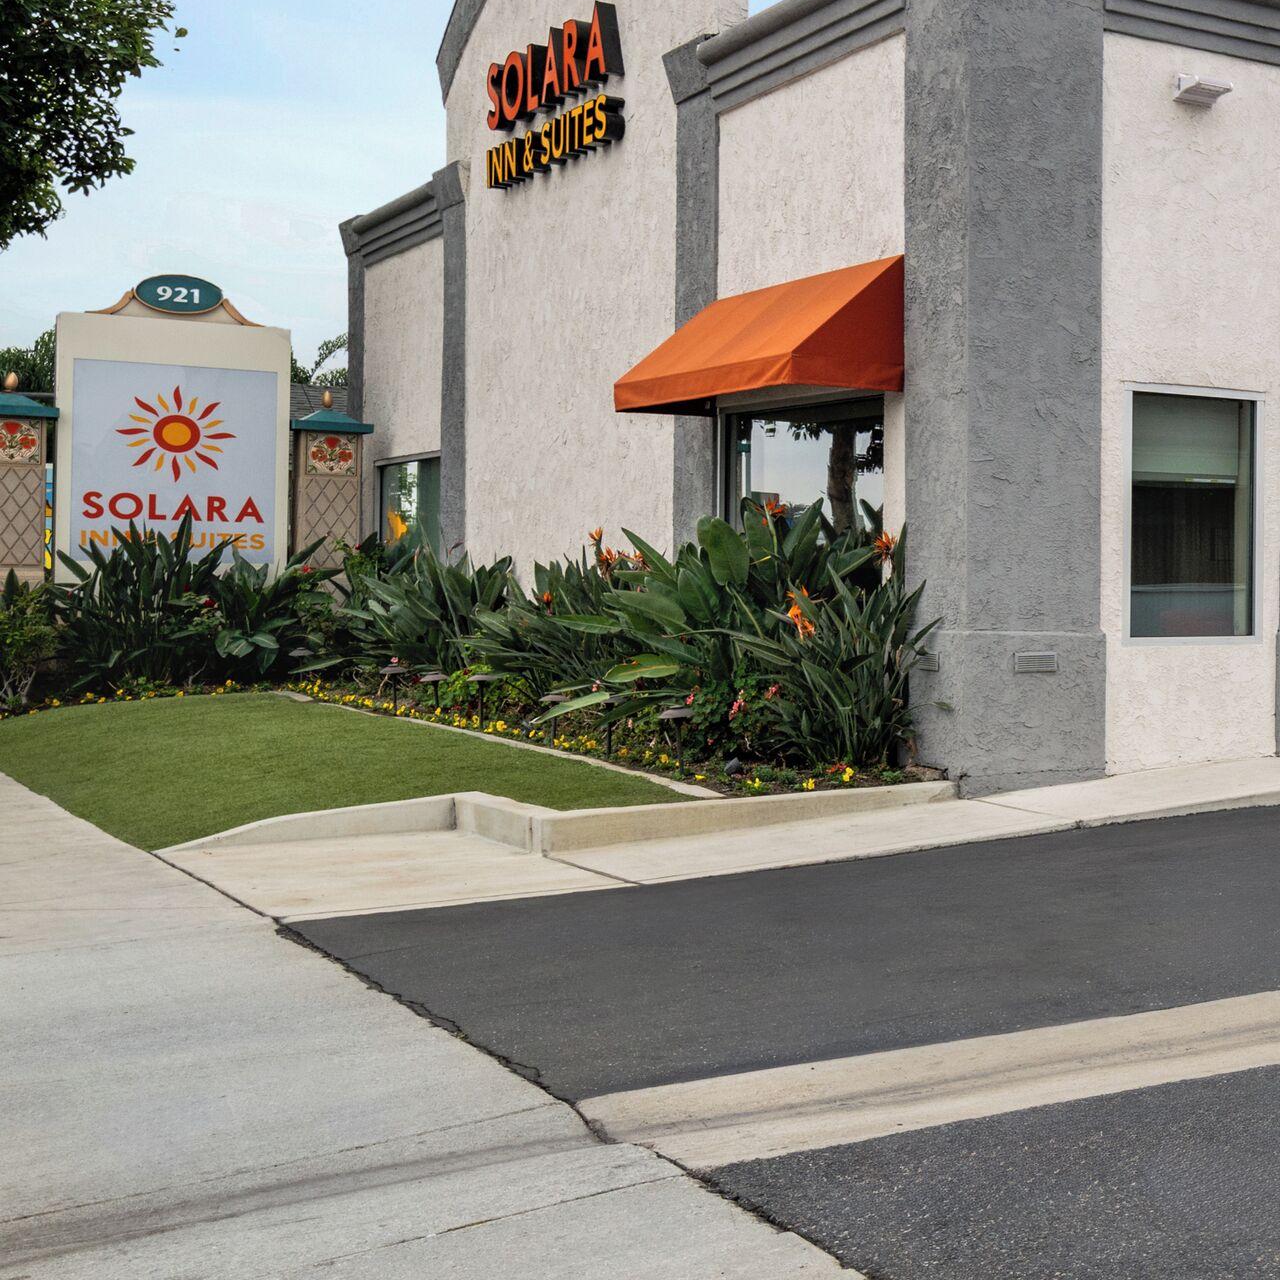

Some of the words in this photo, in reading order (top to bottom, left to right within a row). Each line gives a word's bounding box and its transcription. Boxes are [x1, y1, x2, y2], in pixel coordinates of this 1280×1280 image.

[486, 1, 607, 130] SOLARA
[486, 137, 517, 189] INN
[523, 130, 534, 173] &
[540, 94, 608, 165] SUITES
[156, 285, 200, 304] 921
[81, 490, 265, 524] SOLARA
